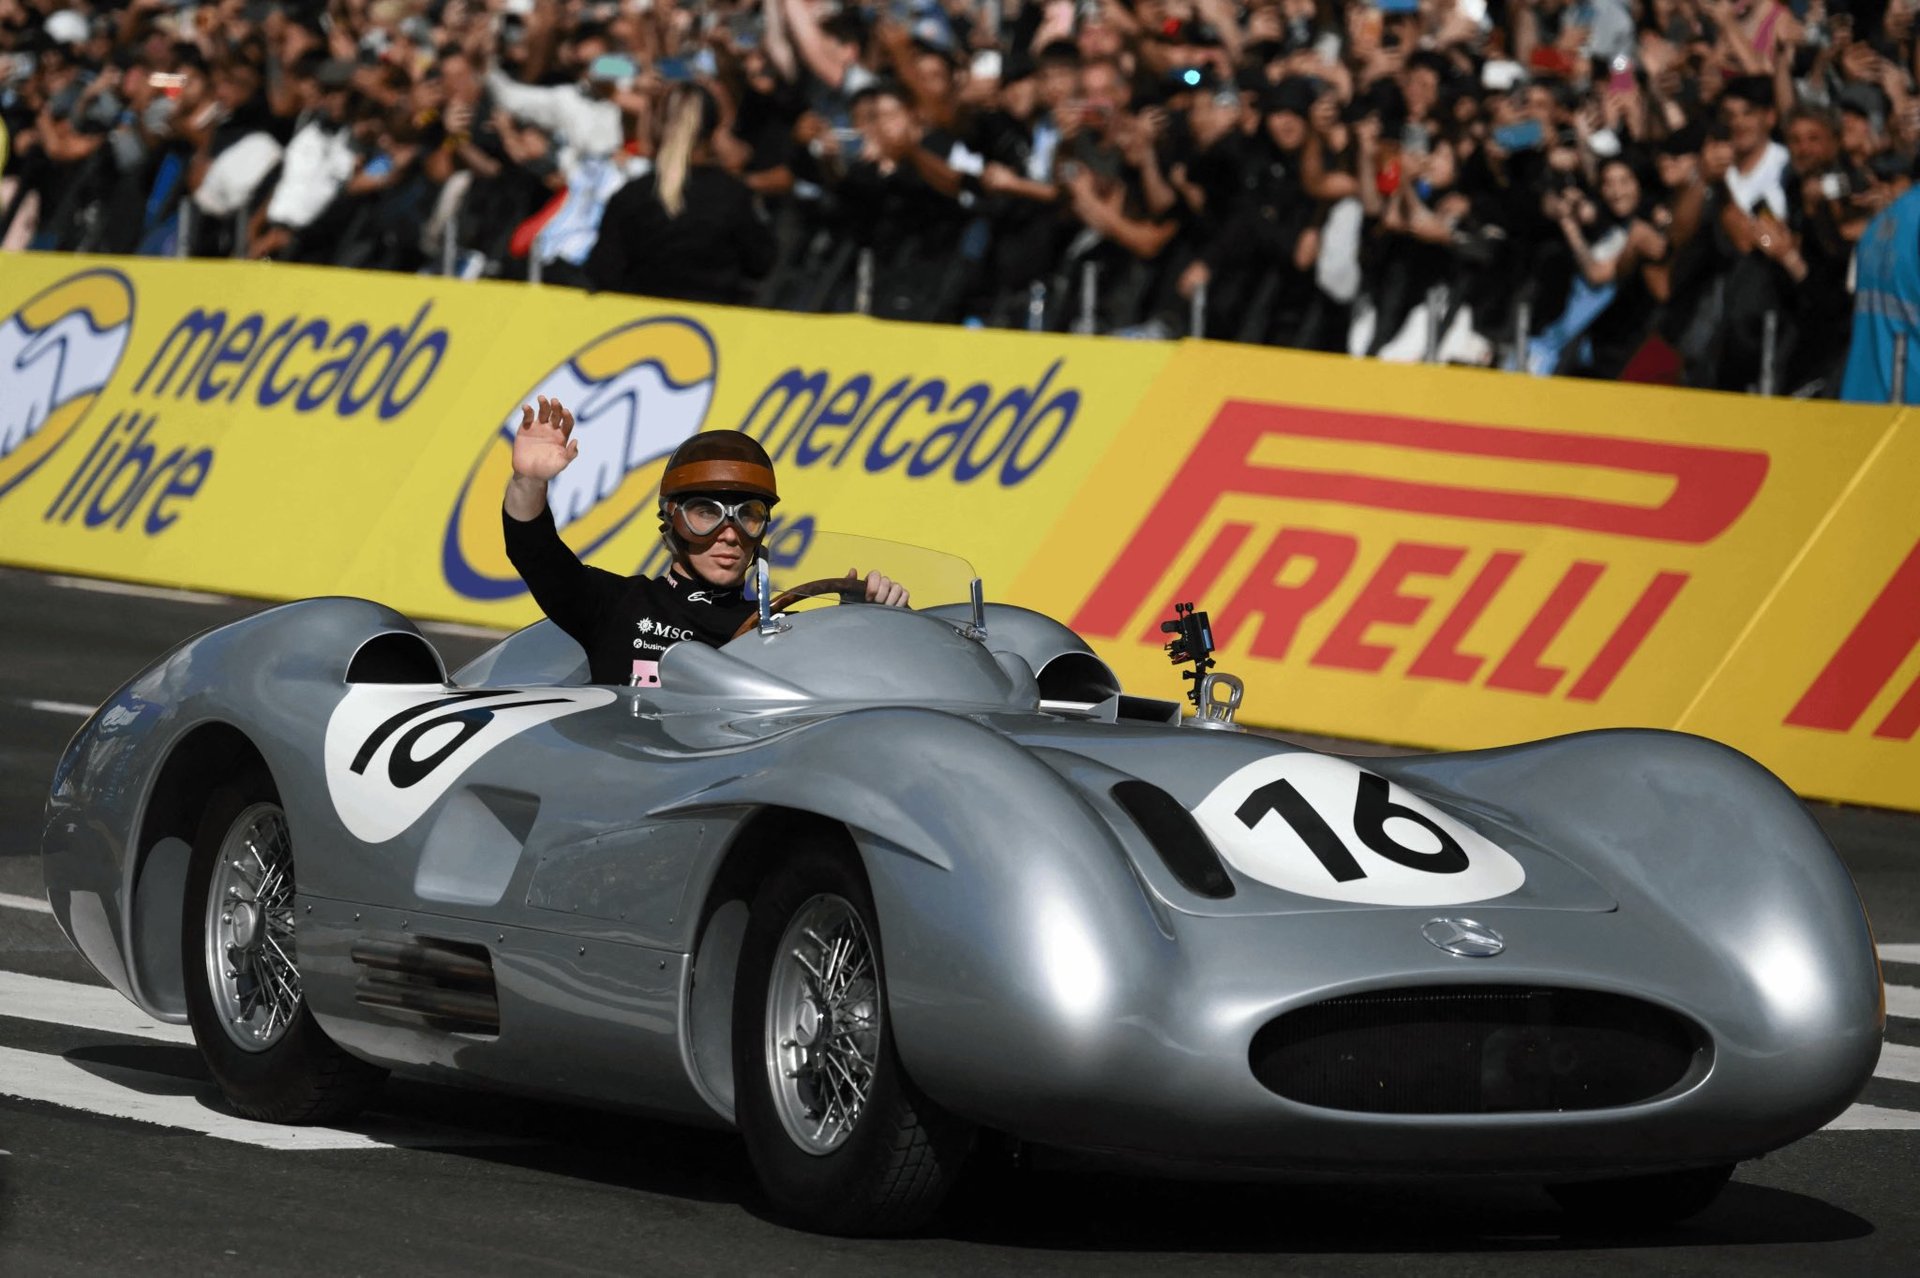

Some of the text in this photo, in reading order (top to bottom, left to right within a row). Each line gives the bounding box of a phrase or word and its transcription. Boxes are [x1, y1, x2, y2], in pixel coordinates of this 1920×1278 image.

[132, 297, 449, 422] mercado
[44, 409, 214, 537] libre
[737, 357, 1082, 488] mercado
[1070, 398, 1771, 701] PIRELLI
[643, 640, 667, 652] busine
[653, 621, 694, 642] MSC
[1234, 770, 1470, 883] 16
